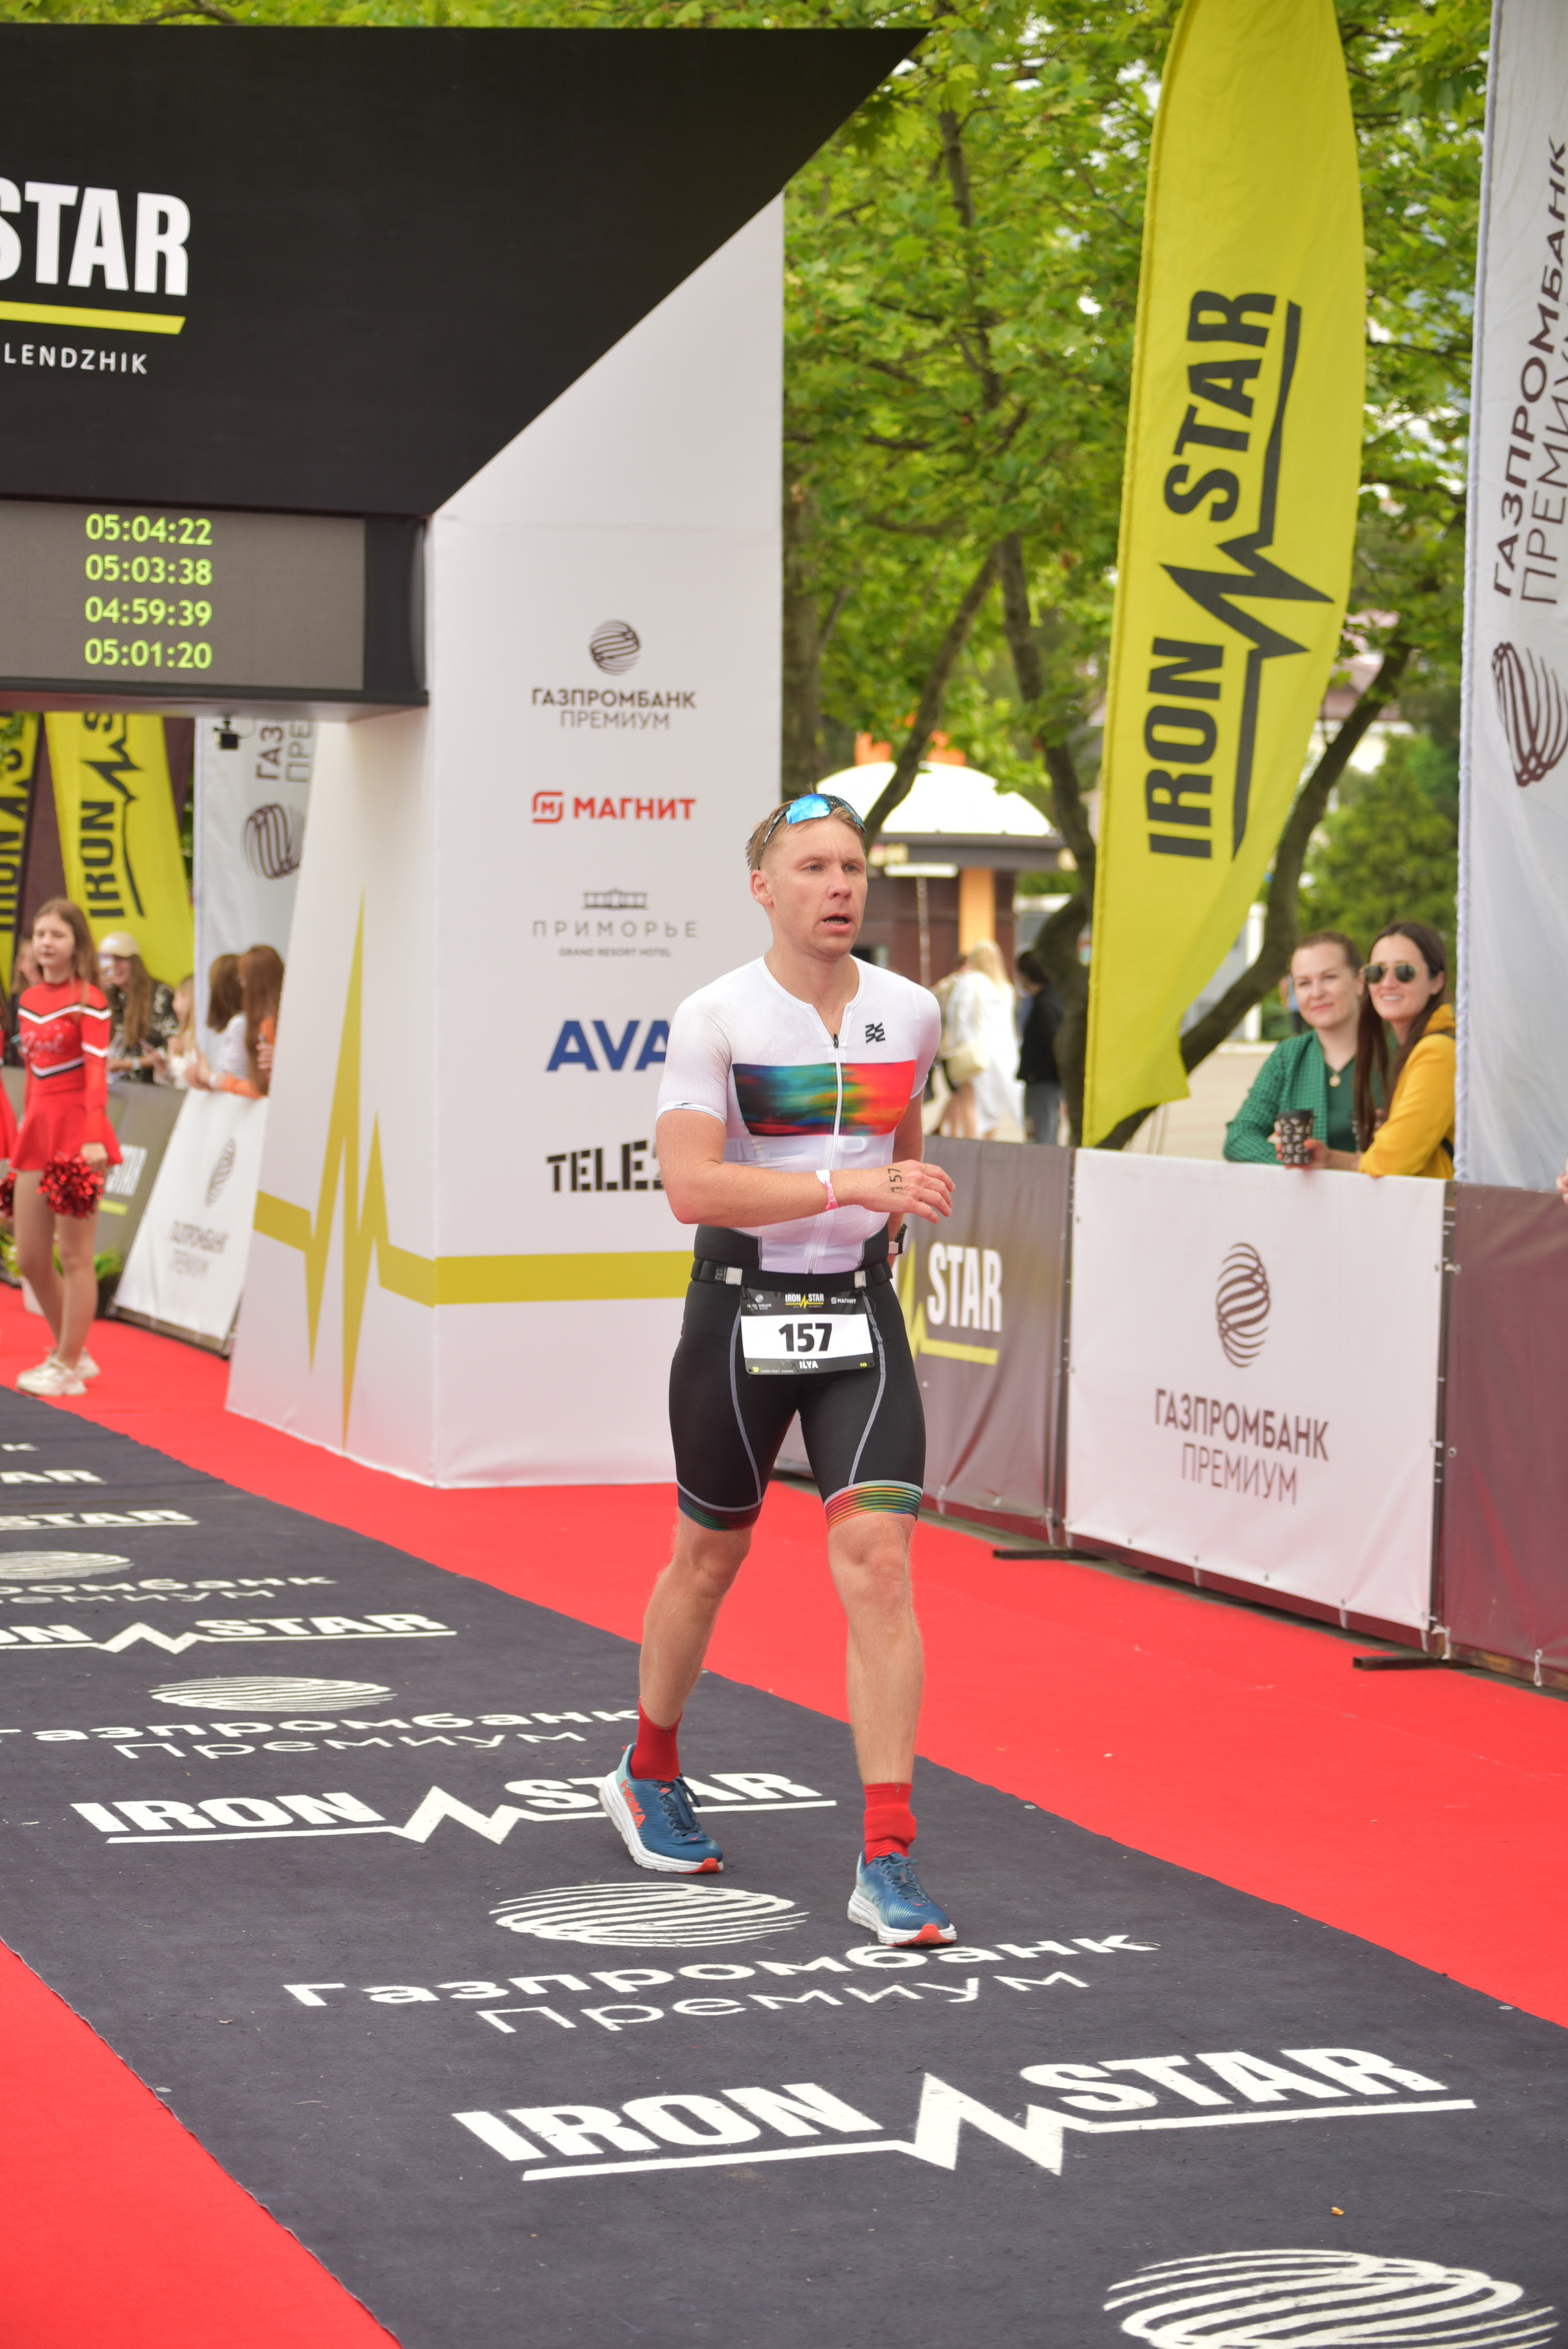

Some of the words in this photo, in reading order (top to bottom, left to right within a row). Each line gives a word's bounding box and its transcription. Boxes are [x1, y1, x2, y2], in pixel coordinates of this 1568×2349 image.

[1493, 132, 1566, 597] ГАЗПРОМБАНК
[1164, 290, 1278, 521] STAR
[85, 513, 213, 545] 05:04:22
[85, 553, 213, 586] 05:03:38
[85, 595, 213, 627] 04:59:39
[85, 637, 213, 669] 05:01:20
[532, 687, 696, 709] ГАЗПРОМБАНК
[560, 709, 670, 730] ПРЕМИУМ
[1144, 637, 1224, 859] IRON
[573, 796, 696, 821] МАГНИТ
[80, 800, 125, 918] IRON
[532, 920, 698, 939] ПРИМОРЬЕ
[558, 947, 595, 957] GRAND
[598, 947, 636, 957] RESORT
[639, 947, 673, 958] HOTEL
[888, 1168, 903, 1192] 157
[785, 1293, 801, 1303] IRON
[808, 1293, 824, 1302] STAR
[927, 1241, 1003, 1333] STAR
[778, 1323, 832, 1352] 157
[799, 1360, 818, 1369] ILYA
[1155, 1388, 1330, 1462] ГАЗПРОМБАНК
[1182, 1442, 1298, 1506] ПРЕМИУМ
[195, 1613, 449, 1636] STAR
[113, 1730, 586, 1759] Премиум
[70, 1791, 386, 1832] IRON
[620, 1779, 646, 1829] HOKA
[282, 1934, 1161, 2007] Газпромбанк
[476, 1970, 1090, 2034] Премиум
[450, 2082, 885, 2162] IRON
[1019, 2047, 1450, 2113] STAR
